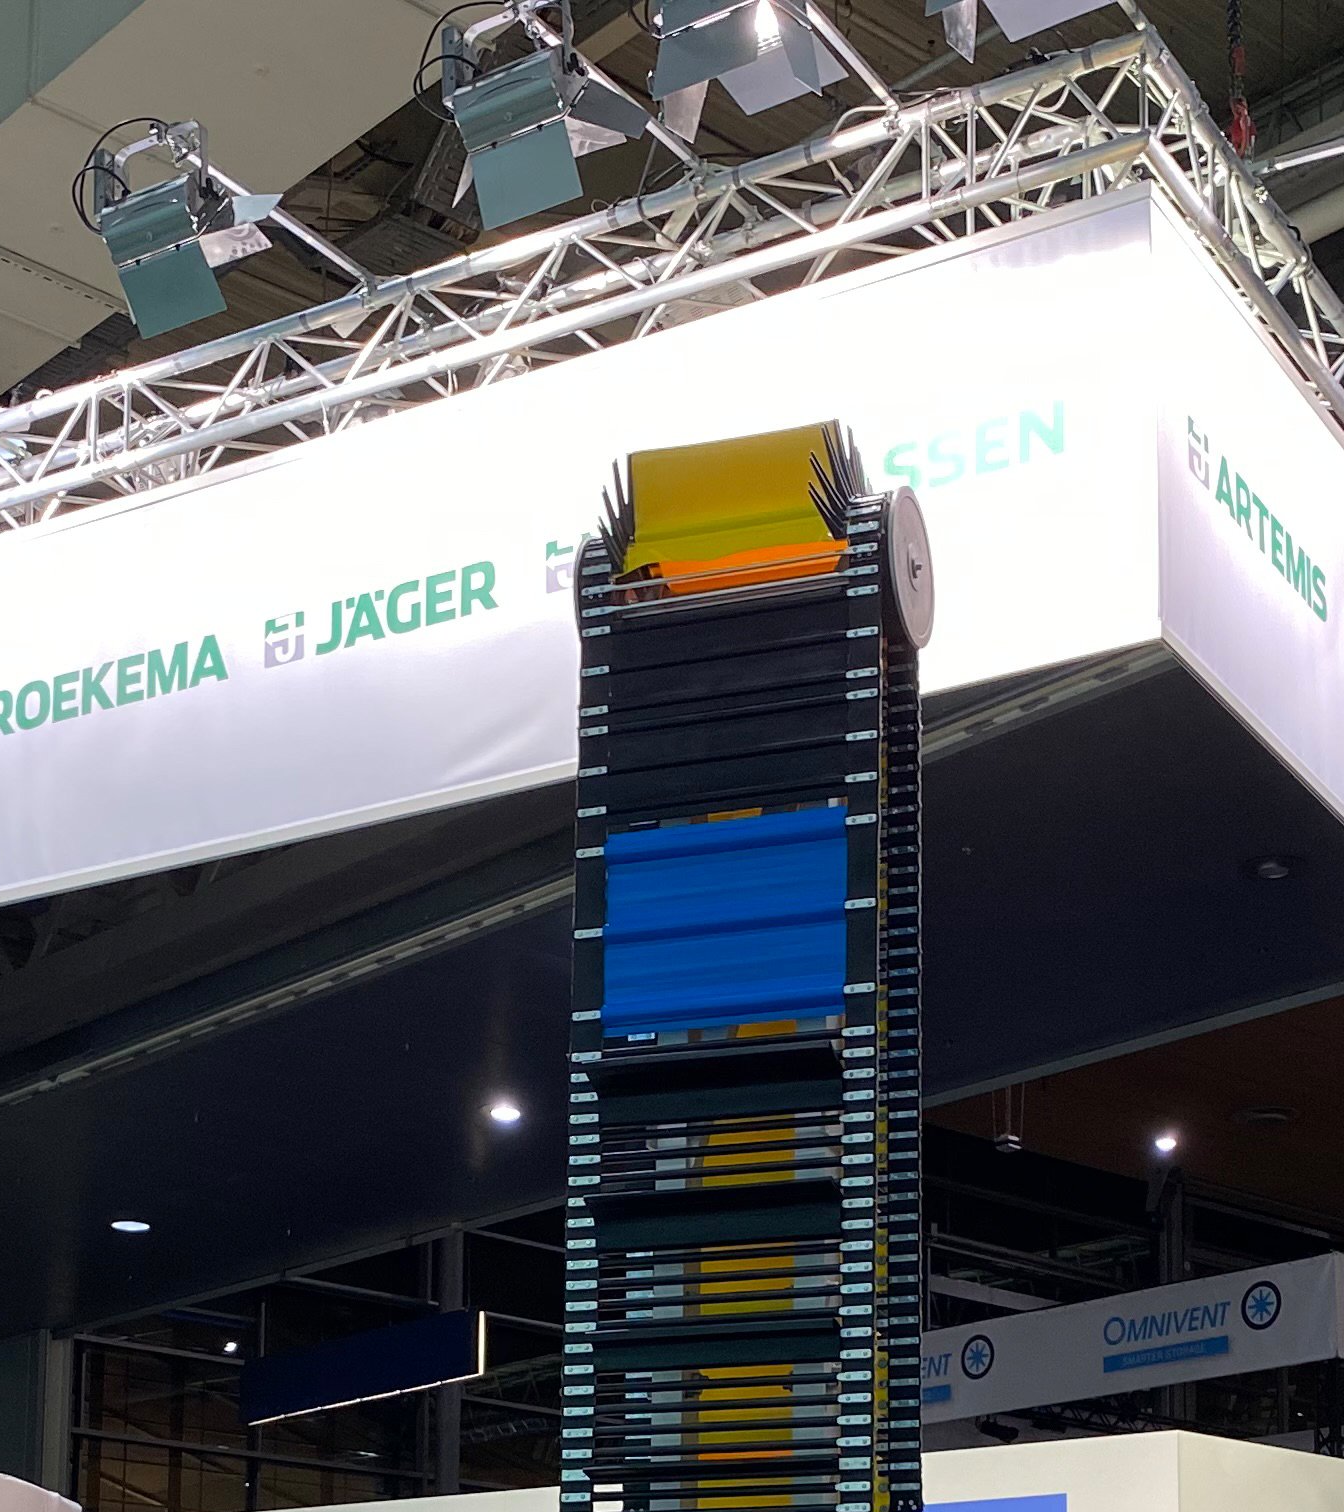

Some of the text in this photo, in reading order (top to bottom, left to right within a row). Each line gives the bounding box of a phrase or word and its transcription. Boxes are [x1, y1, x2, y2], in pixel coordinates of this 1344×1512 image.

[1215, 455, 1328, 623] ARTEMIS
[315, 561, 500, 656] JÄGER
[1104, 1301, 1231, 1345] OMNIVENT
